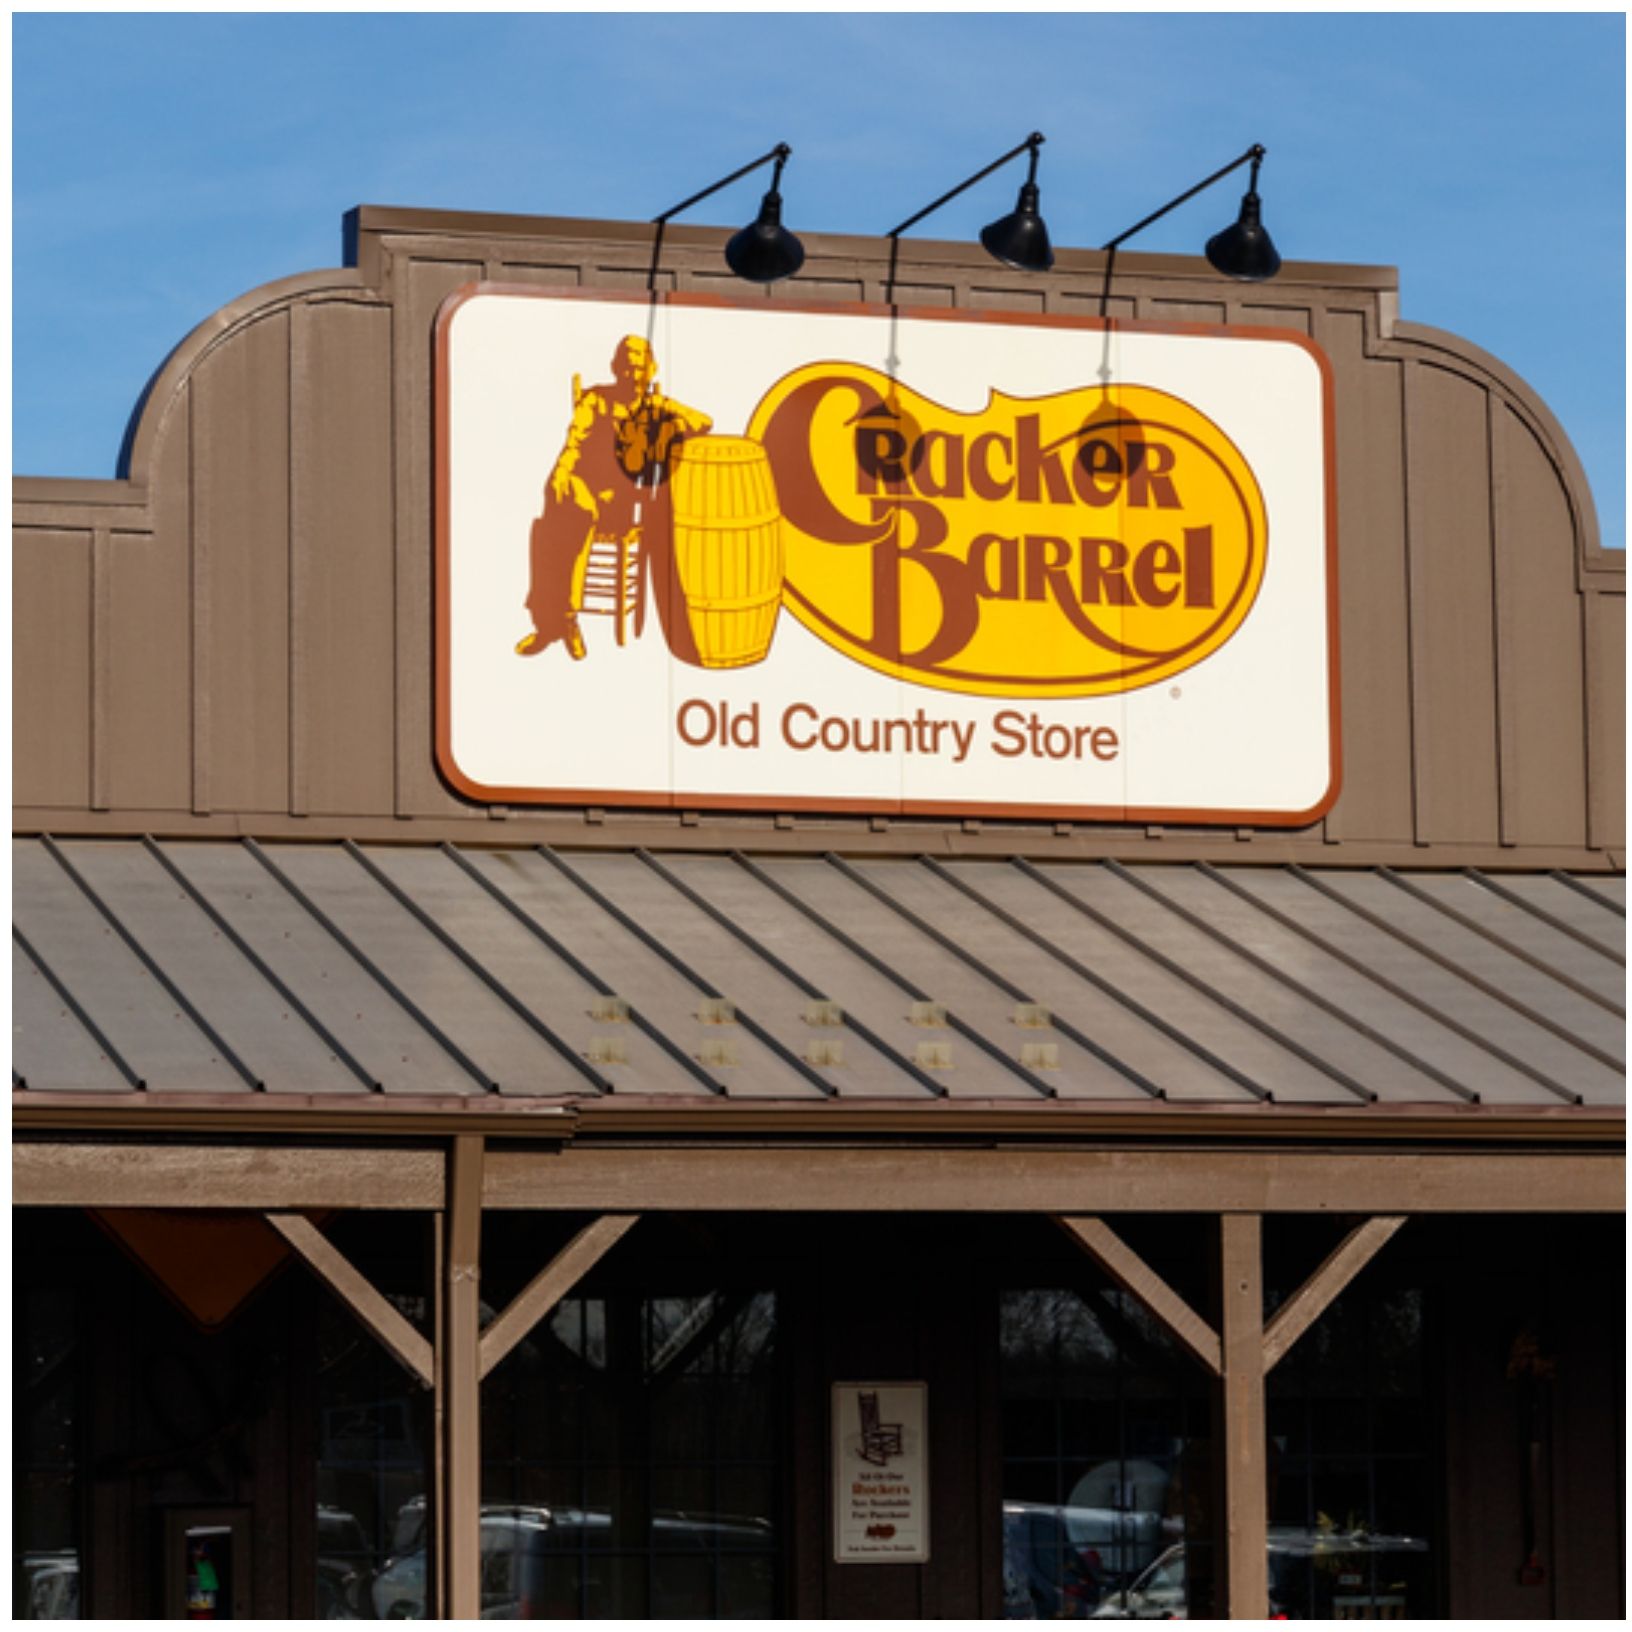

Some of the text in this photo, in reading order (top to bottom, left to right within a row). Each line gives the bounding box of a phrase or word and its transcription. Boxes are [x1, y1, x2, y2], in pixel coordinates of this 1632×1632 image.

[762, 376, 1184, 546] Cracker
[870, 498, 1216, 666] Barrel
[676, 699, 1119, 762] Old Country Store
[852, 1482, 910, 1495] Rockers
